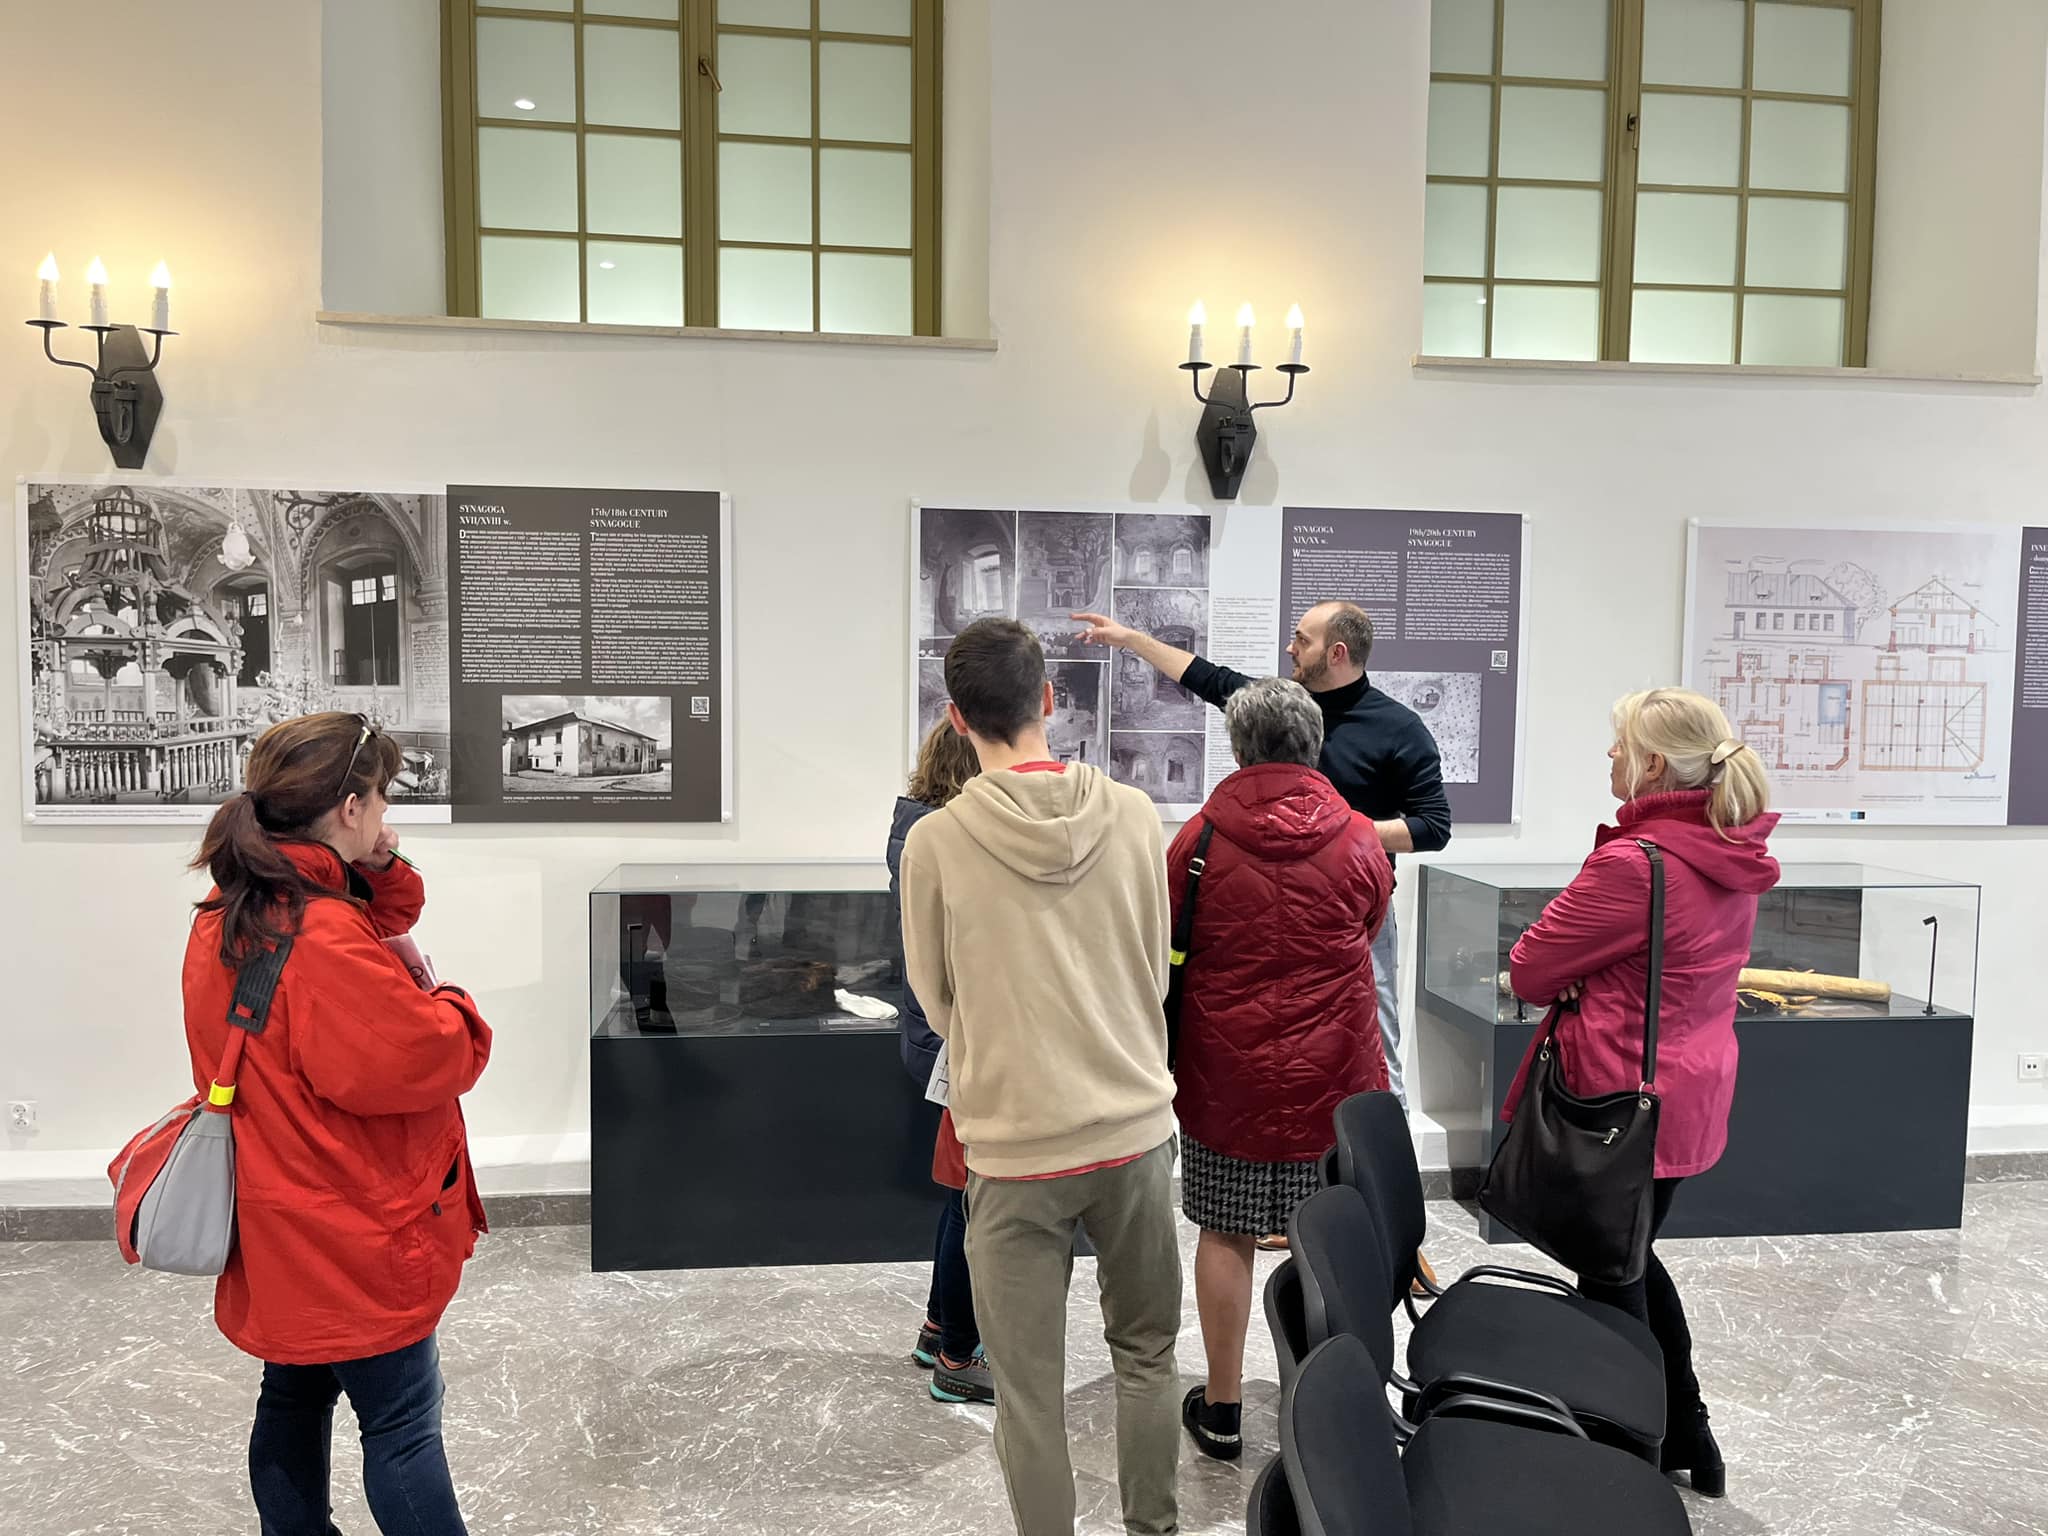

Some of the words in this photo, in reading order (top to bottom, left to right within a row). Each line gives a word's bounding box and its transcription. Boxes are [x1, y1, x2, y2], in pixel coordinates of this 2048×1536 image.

[459, 504, 505, 514] SYNAGOGA
[629, 508, 669, 518] CENTURY
[459, 515, 501, 526] XVII/XVIII
[589, 519, 641, 529] SYNAGOGUE
[1293, 525, 1334, 534] SYNAGOGA
[1442, 528, 1477, 538] CENTURY
[1407, 538, 1453, 548] SYNAGOGUE
